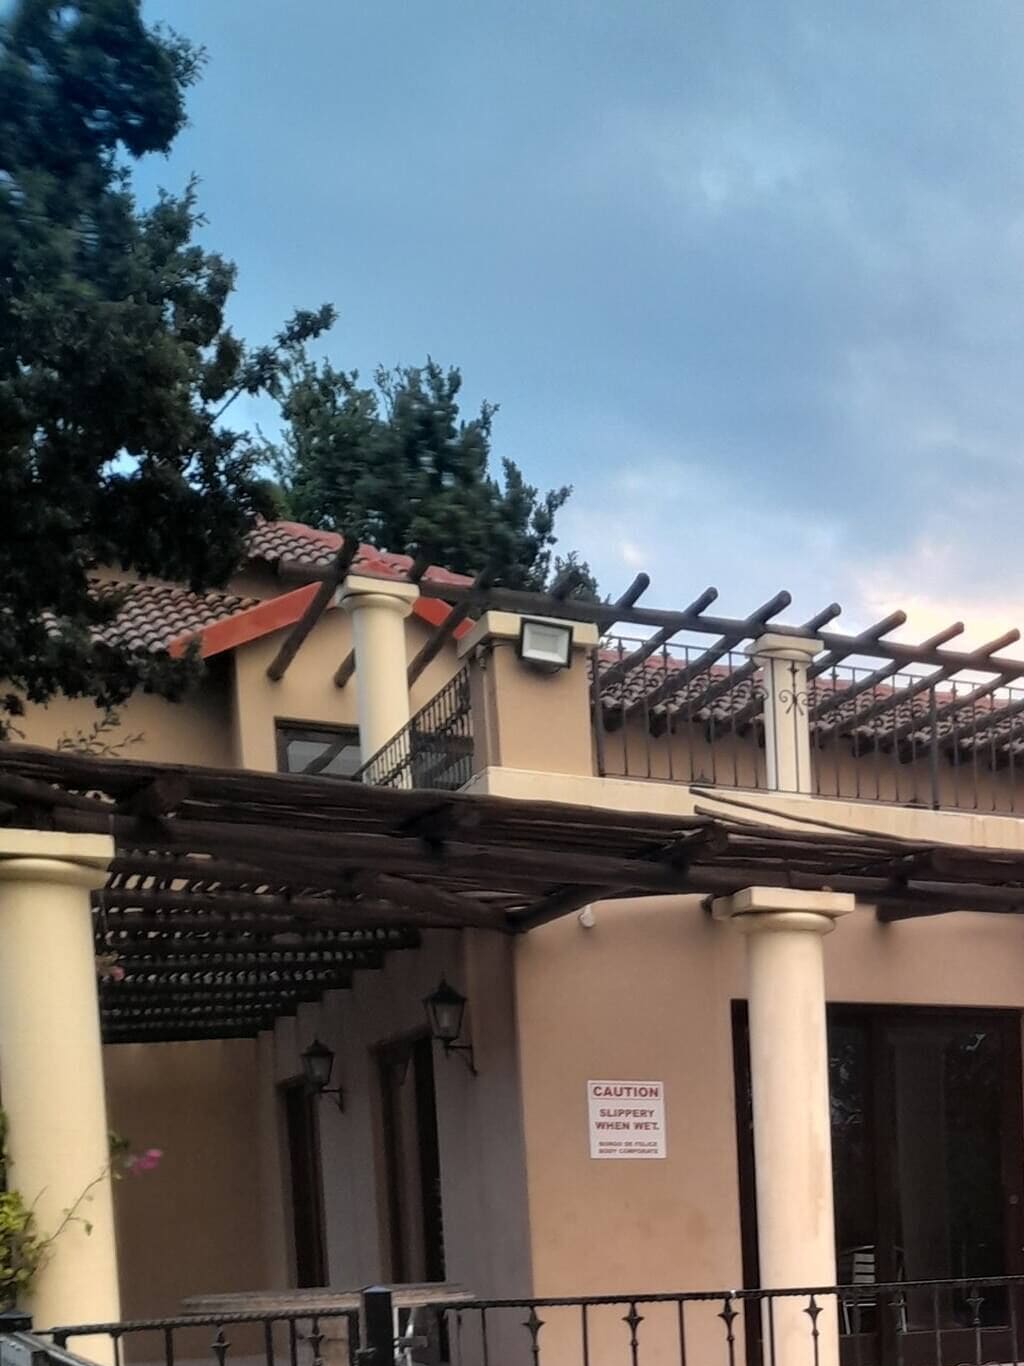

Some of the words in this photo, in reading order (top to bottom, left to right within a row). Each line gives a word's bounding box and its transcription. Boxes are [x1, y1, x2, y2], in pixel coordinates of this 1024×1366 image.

[593, 1086, 659, 1097] CAUTION
[599, 1108, 655, 1117] SLIPPERY
[595, 1121, 630, 1130] WHEN
